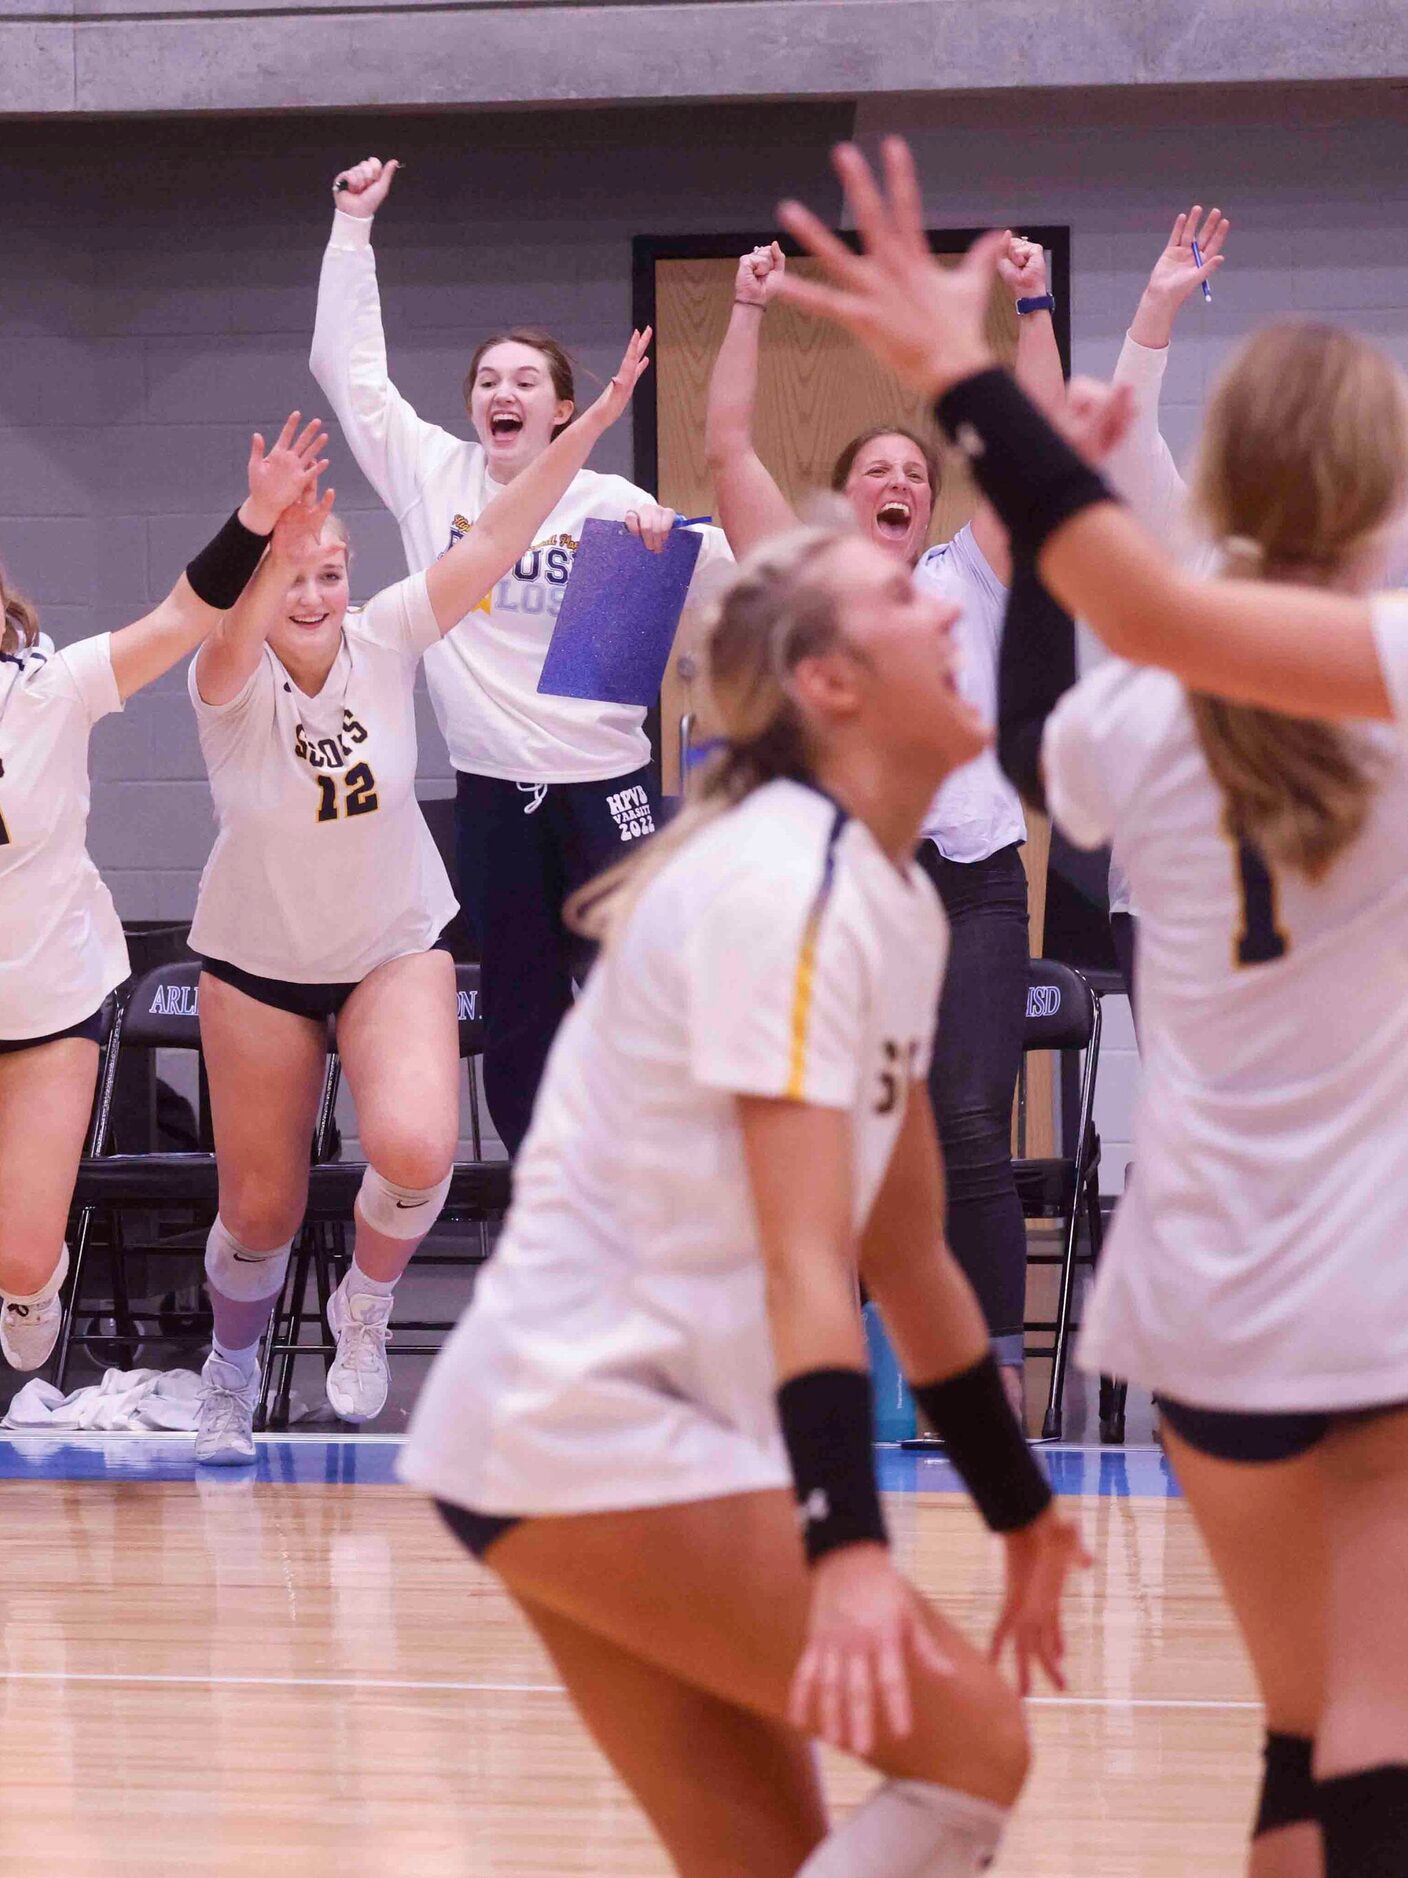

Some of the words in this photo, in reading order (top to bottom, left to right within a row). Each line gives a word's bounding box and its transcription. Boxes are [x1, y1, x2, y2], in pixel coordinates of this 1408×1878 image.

[314, 760, 380, 823] 12
[606, 785, 648, 815] HPVB
[618, 815, 655, 842] 2022
[1025, 986, 1061, 1018] ISD
